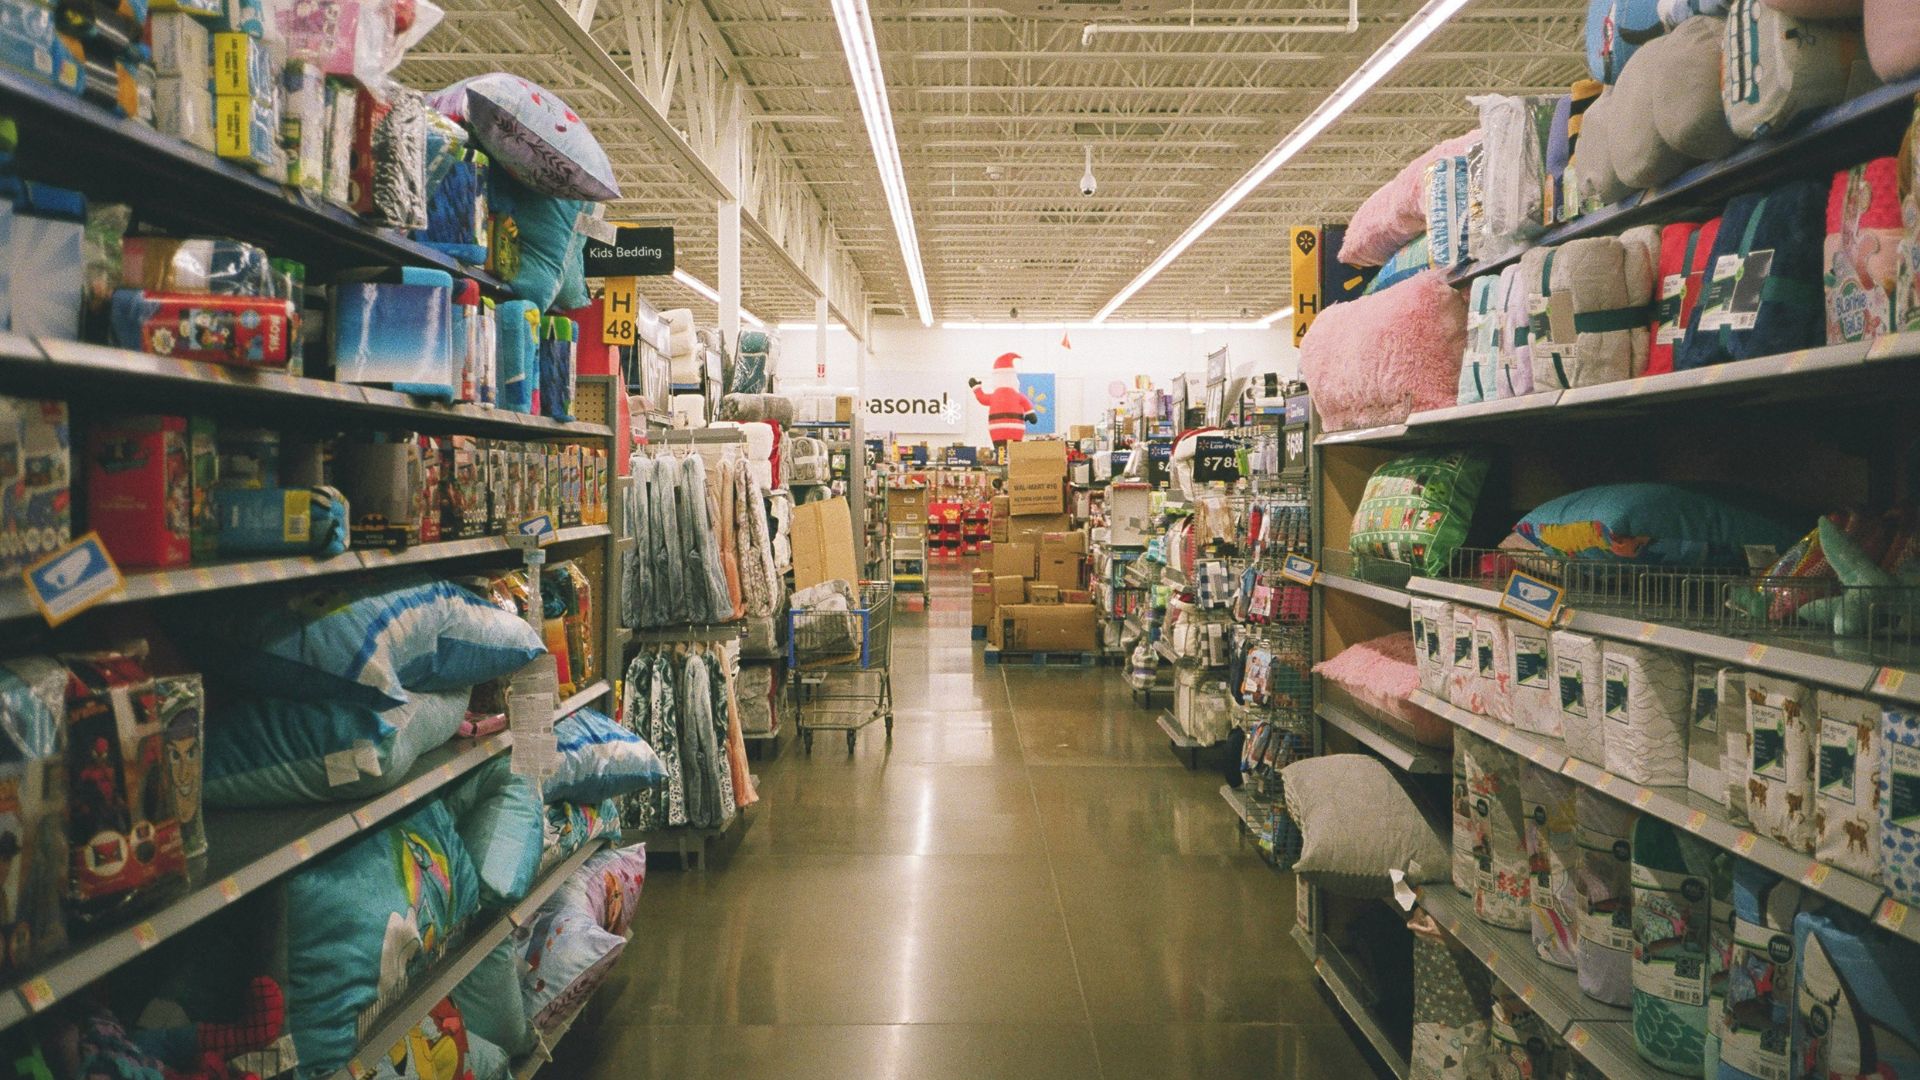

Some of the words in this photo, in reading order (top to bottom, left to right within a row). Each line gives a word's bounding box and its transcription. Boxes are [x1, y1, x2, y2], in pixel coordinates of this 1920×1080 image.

[590, 247, 612, 258] Kids
[616, 246, 662, 259] Bedding
[612, 292, 630, 313] H
[1299, 294, 1316, 314] H
[606, 320, 632, 339] 48
[866, 392, 948, 414] asonal
